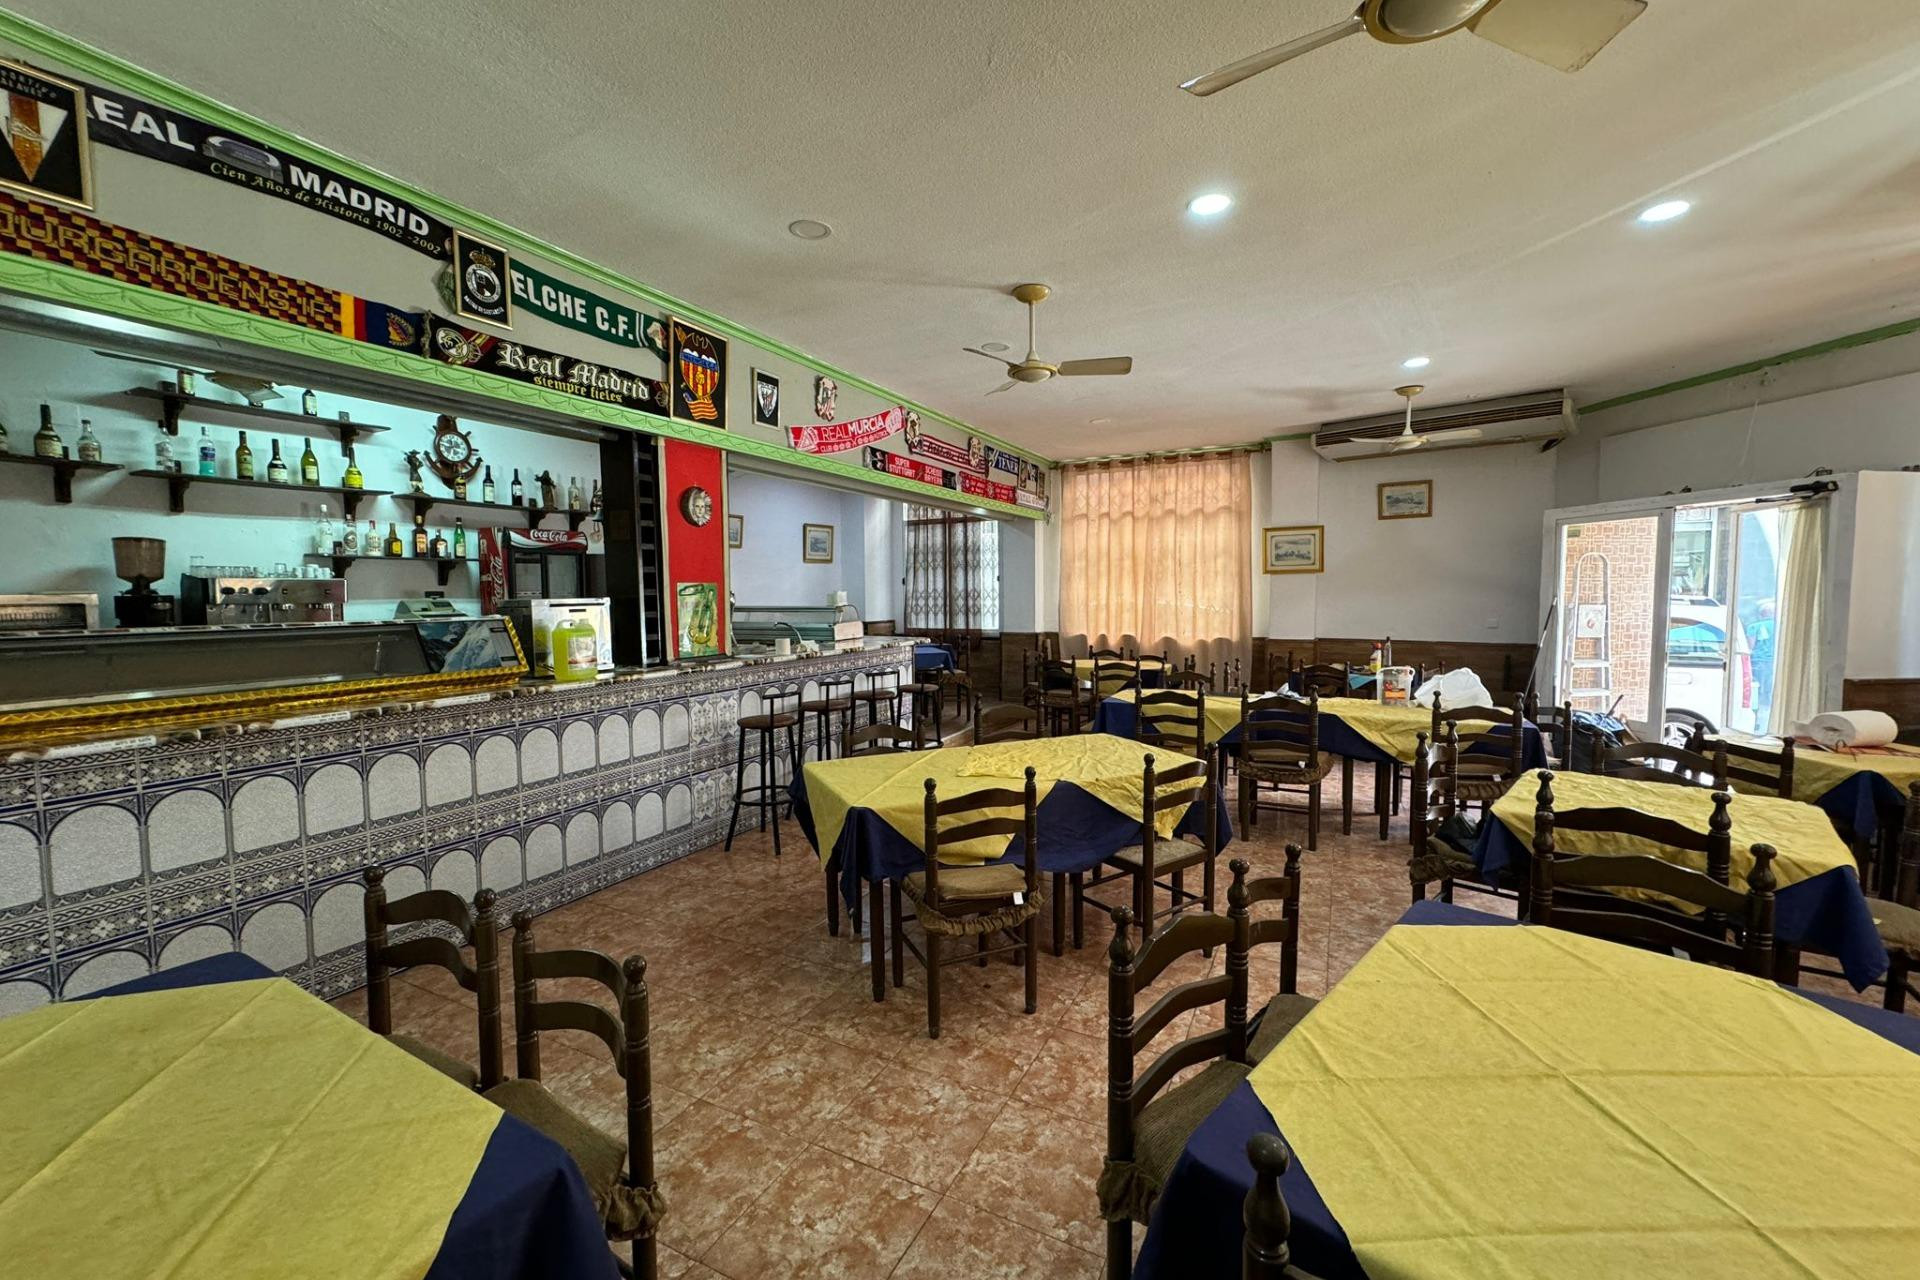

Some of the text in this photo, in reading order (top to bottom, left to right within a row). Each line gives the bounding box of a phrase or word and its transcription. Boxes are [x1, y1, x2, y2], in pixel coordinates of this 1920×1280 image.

[85, 95, 430, 236] EAL MADRID
[210, 162, 247, 181] Cien
[251, 174, 290, 195] Años
[294, 189, 310, 203] de
[315, 196, 371, 225] Historia
[376, 219, 403, 237] 1902
[510, 269, 588, 324] ELCHE
[595, 306, 634, 340] C.F.
[496, 341, 650, 400] Real Madrid
[534, 375, 623, 403] siempre fieles
[821, 415, 886, 441] REAL MURCIA
